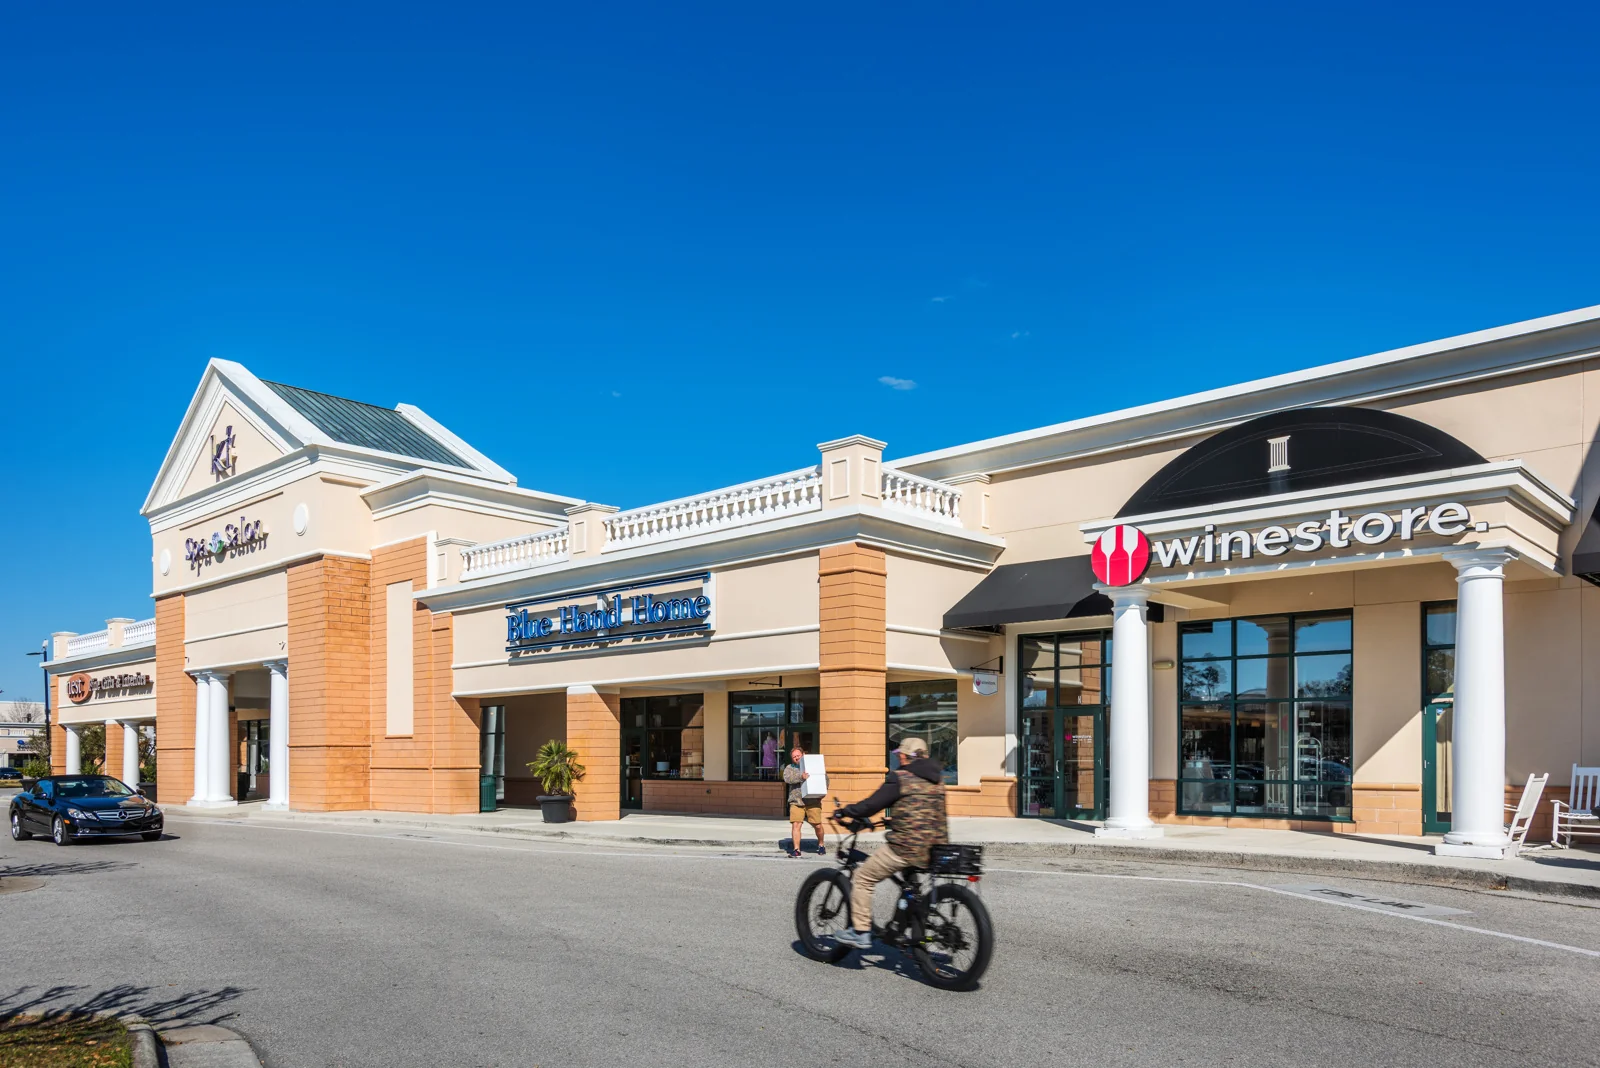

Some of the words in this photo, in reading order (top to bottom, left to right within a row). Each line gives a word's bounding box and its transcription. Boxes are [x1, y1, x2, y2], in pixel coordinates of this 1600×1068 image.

[185, 537, 208, 563] Spa
[225, 516, 264, 549] Salon
[1155, 501, 1489, 569] winestore.
[505, 608, 553, 642] Blue
[557, 593, 624, 634] Hand
[629, 593, 711, 626] Home
